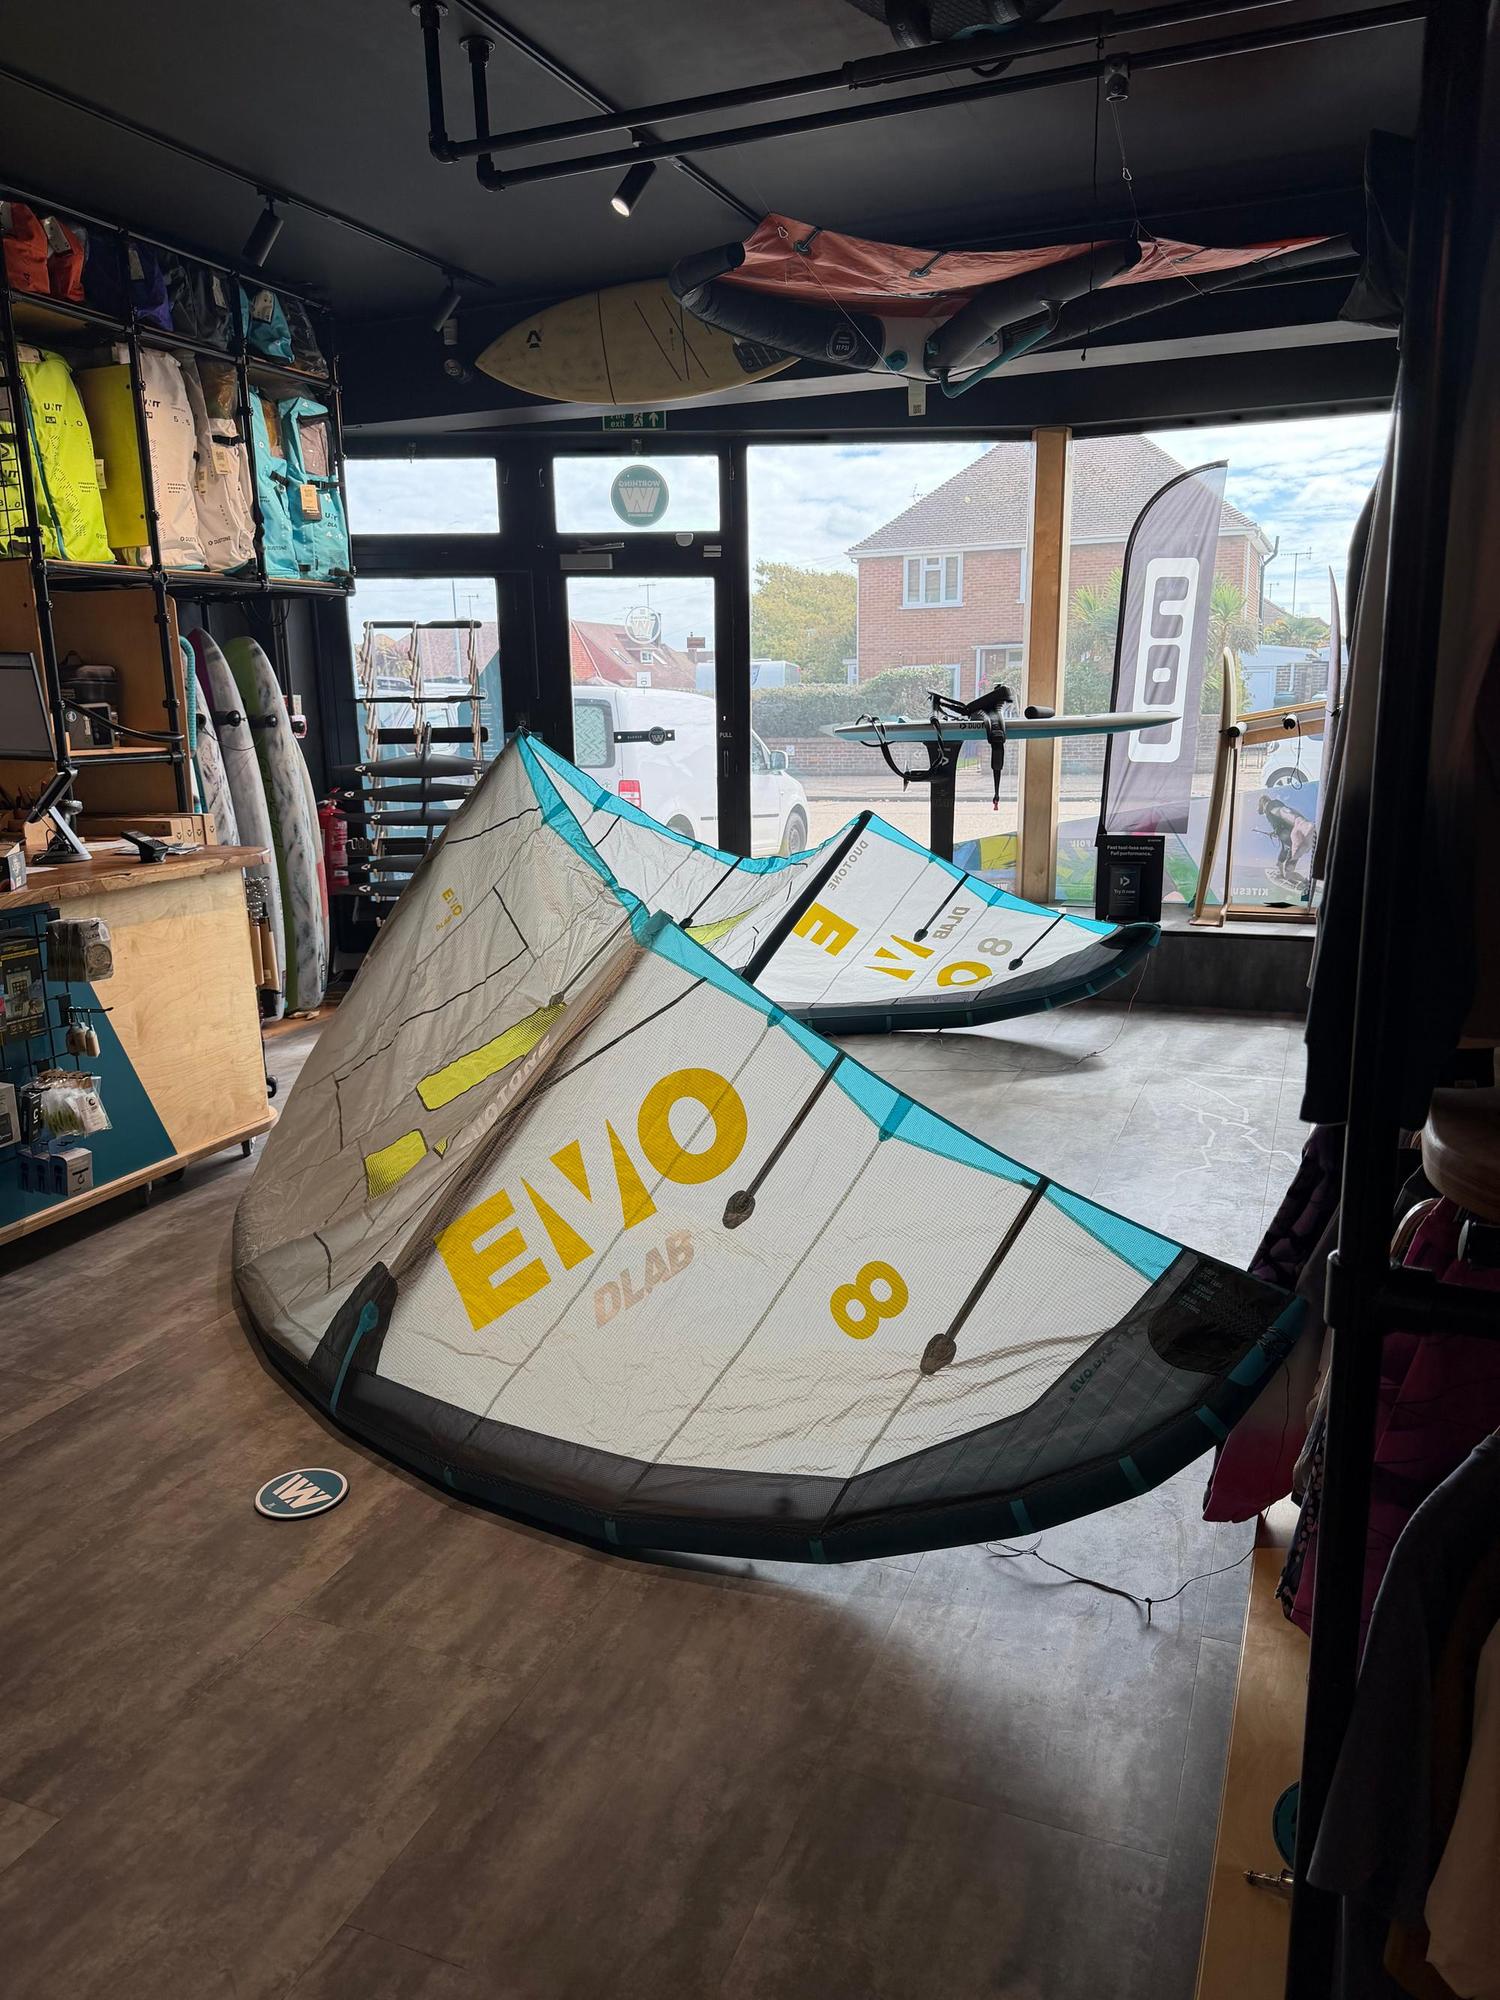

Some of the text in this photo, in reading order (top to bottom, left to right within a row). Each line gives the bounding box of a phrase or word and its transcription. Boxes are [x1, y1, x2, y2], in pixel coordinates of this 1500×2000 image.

[610, 420, 626, 428] exit
[967, 721, 986, 729] DUOT
[433, 1067, 749, 1332] EVO
[592, 1228, 695, 1328] DLAB
[829, 1260, 909, 1340] 8
